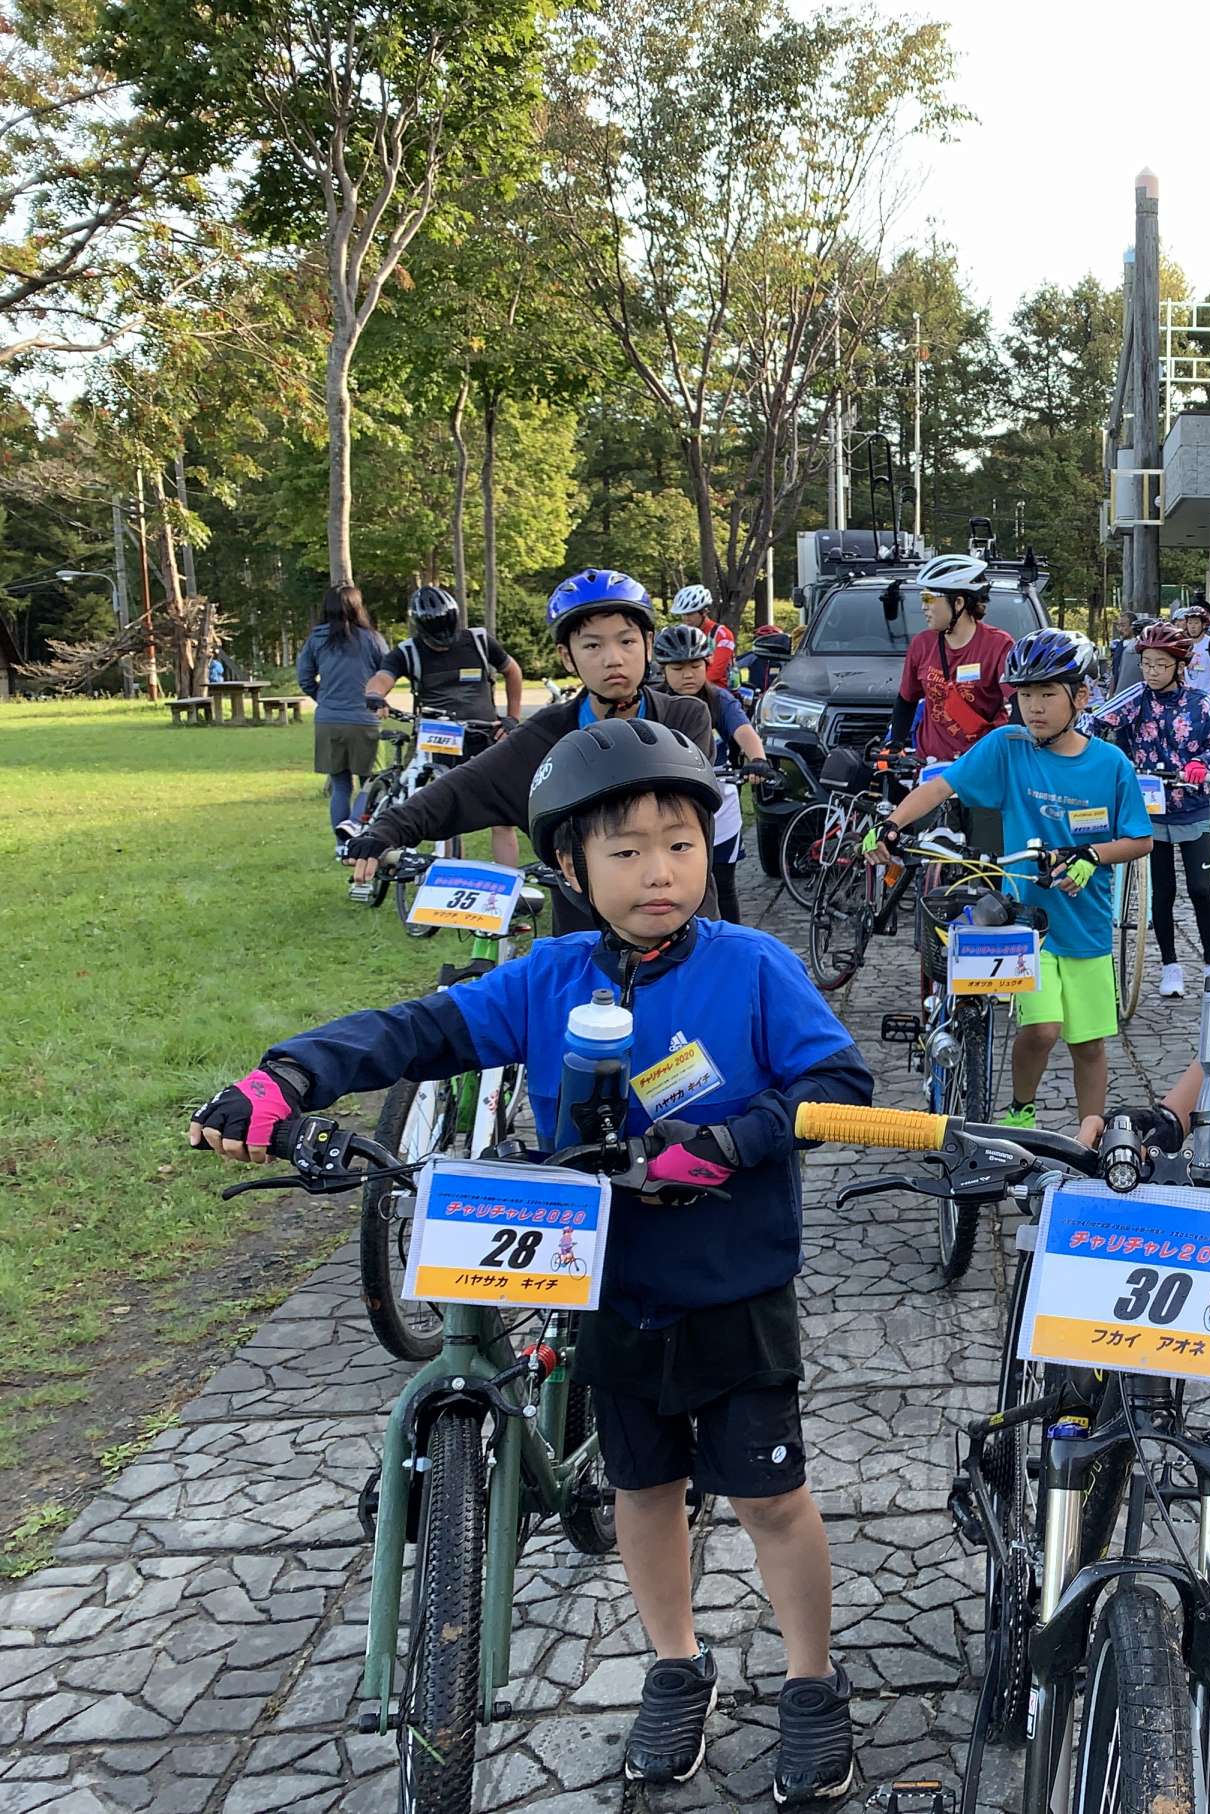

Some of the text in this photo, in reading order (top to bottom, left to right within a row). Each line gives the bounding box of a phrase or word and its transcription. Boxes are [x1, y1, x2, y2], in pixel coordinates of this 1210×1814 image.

[446, 890, 480, 909] 35
[990, 958, 1004, 977] 7
[674, 1048, 695, 1066] 2020
[655, 1089, 685, 1112] ハヤサカ
[479, 1228, 544, 1270] 28
[455, 1273, 559, 1290] ハヤサカ キイチ
[1113, 1267, 1195, 1325] 30
[1090, 1328, 1208, 1357] フカイ アオネ
